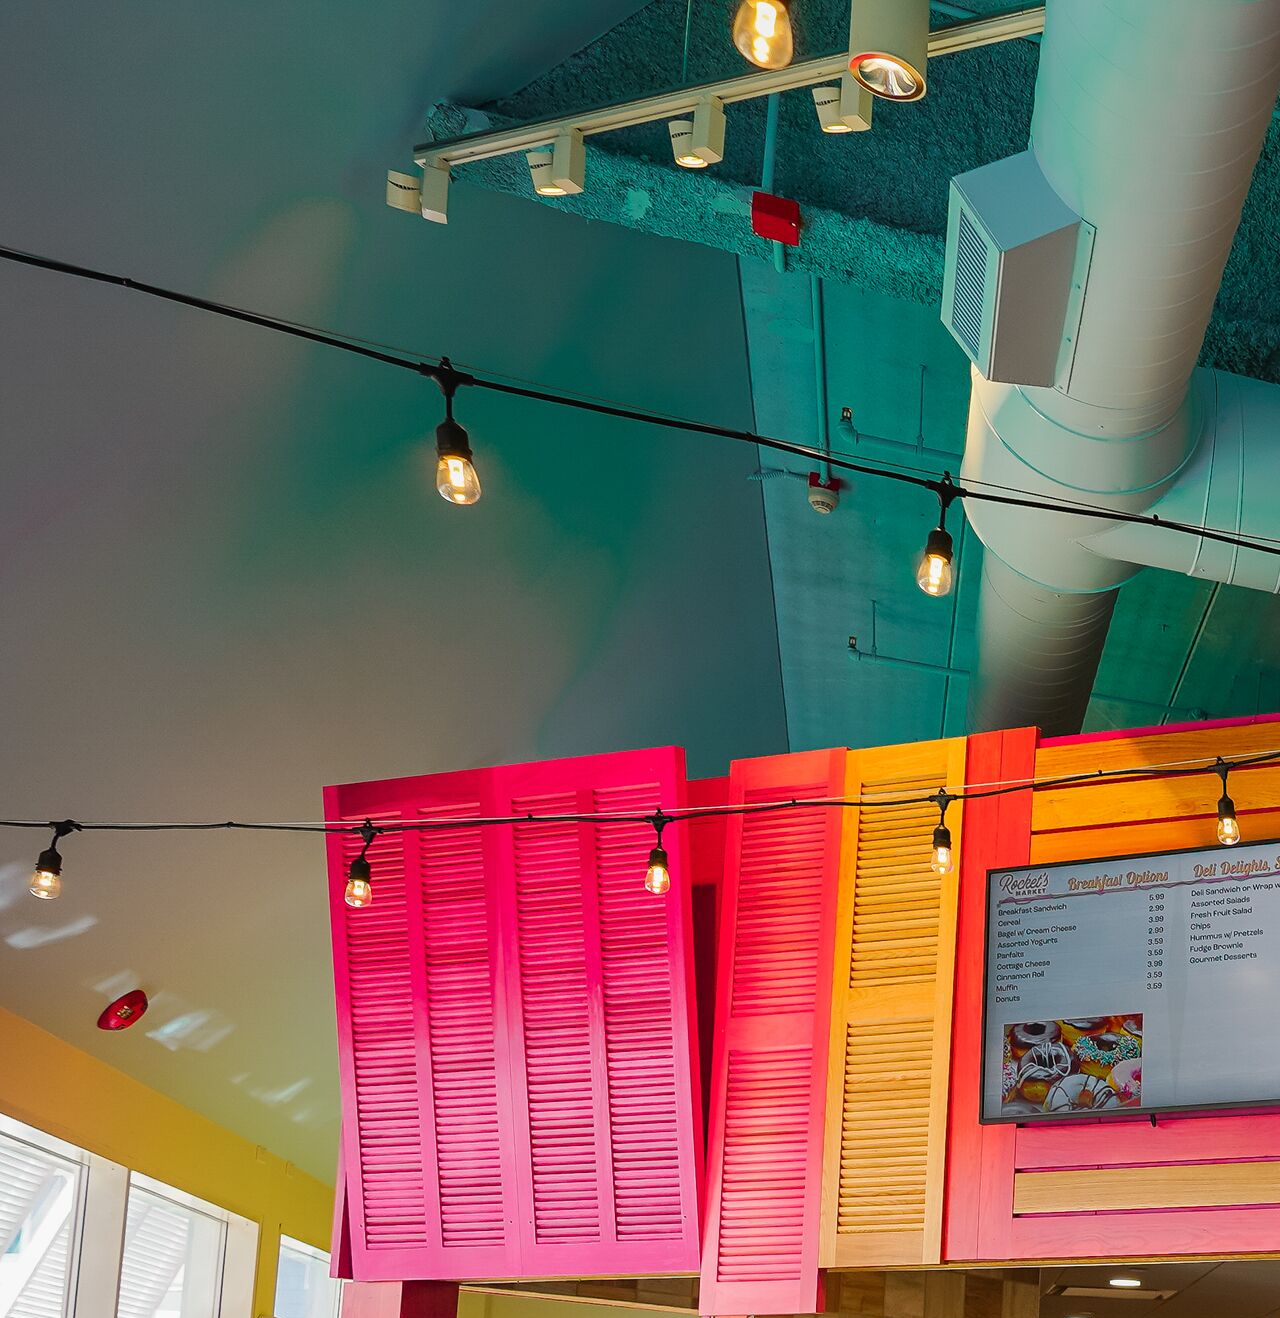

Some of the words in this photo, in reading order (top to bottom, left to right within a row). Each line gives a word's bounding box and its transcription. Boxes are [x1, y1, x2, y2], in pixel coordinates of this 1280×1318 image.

[1193, 863, 1217, 878] Deli
[999, 872, 1049, 894] Rocket's
[1068, 874, 1123, 891] Breakfast
[1125, 870, 1169, 888] Options
[1016, 888, 1047, 896] MARKET
[1191, 889, 1204, 897] Deli
[1205, 886, 1241, 895] Sandwich
[1191, 898, 1225, 908] Assorted
[1226, 896, 1251, 905] Salads
[998, 907, 1033, 916] Breakfast
[1033, 903, 1067, 913] Sandwich
[1148, 904, 1165, 912] 2.99
[1191, 911, 1212, 919] Fresh
[1213, 909, 1231, 917] Fruit
[1232, 906, 1253, 915] Salad
[998, 918, 1021, 927] Cereal
[1148, 915, 1164, 923] 3.99
[1148, 926, 1164, 934] 2.99
[1190, 923, 1211, 931] Chips
[997, 930, 1016, 939] Bagel
[1017, 928, 1026, 937] w/
[1051, 925, 1077, 933] Cheese
[1190, 933, 1223, 941] Hummus
[1223, 931, 1233, 939] w/
[1233, 928, 1264, 937] Pretzels
[997, 939, 1030, 948] Assorted
[1030, 938, 1058, 947] Yogurts
[1148, 937, 1164, 945] 3.59
[1190, 945, 1212, 953] Fudge
[1213, 941, 1244, 950] Brownie
[997, 951, 1024, 959] Parfaits
[1147, 948, 1163, 956] 3.59
[1189, 955, 1223, 964] Gourmet
[1223, 953, 1258, 961] Desserts
[1024, 960, 1051, 968] Cheese
[1147, 960, 1163, 968] 3.99
[996, 973, 1031, 981] Cinnamon
[1032, 970, 1045, 978] Roll
[1147, 971, 1163, 979] 3.59
[1146, 982, 1163, 990] 3.59
[996, 995, 1021, 1003] Donuts
